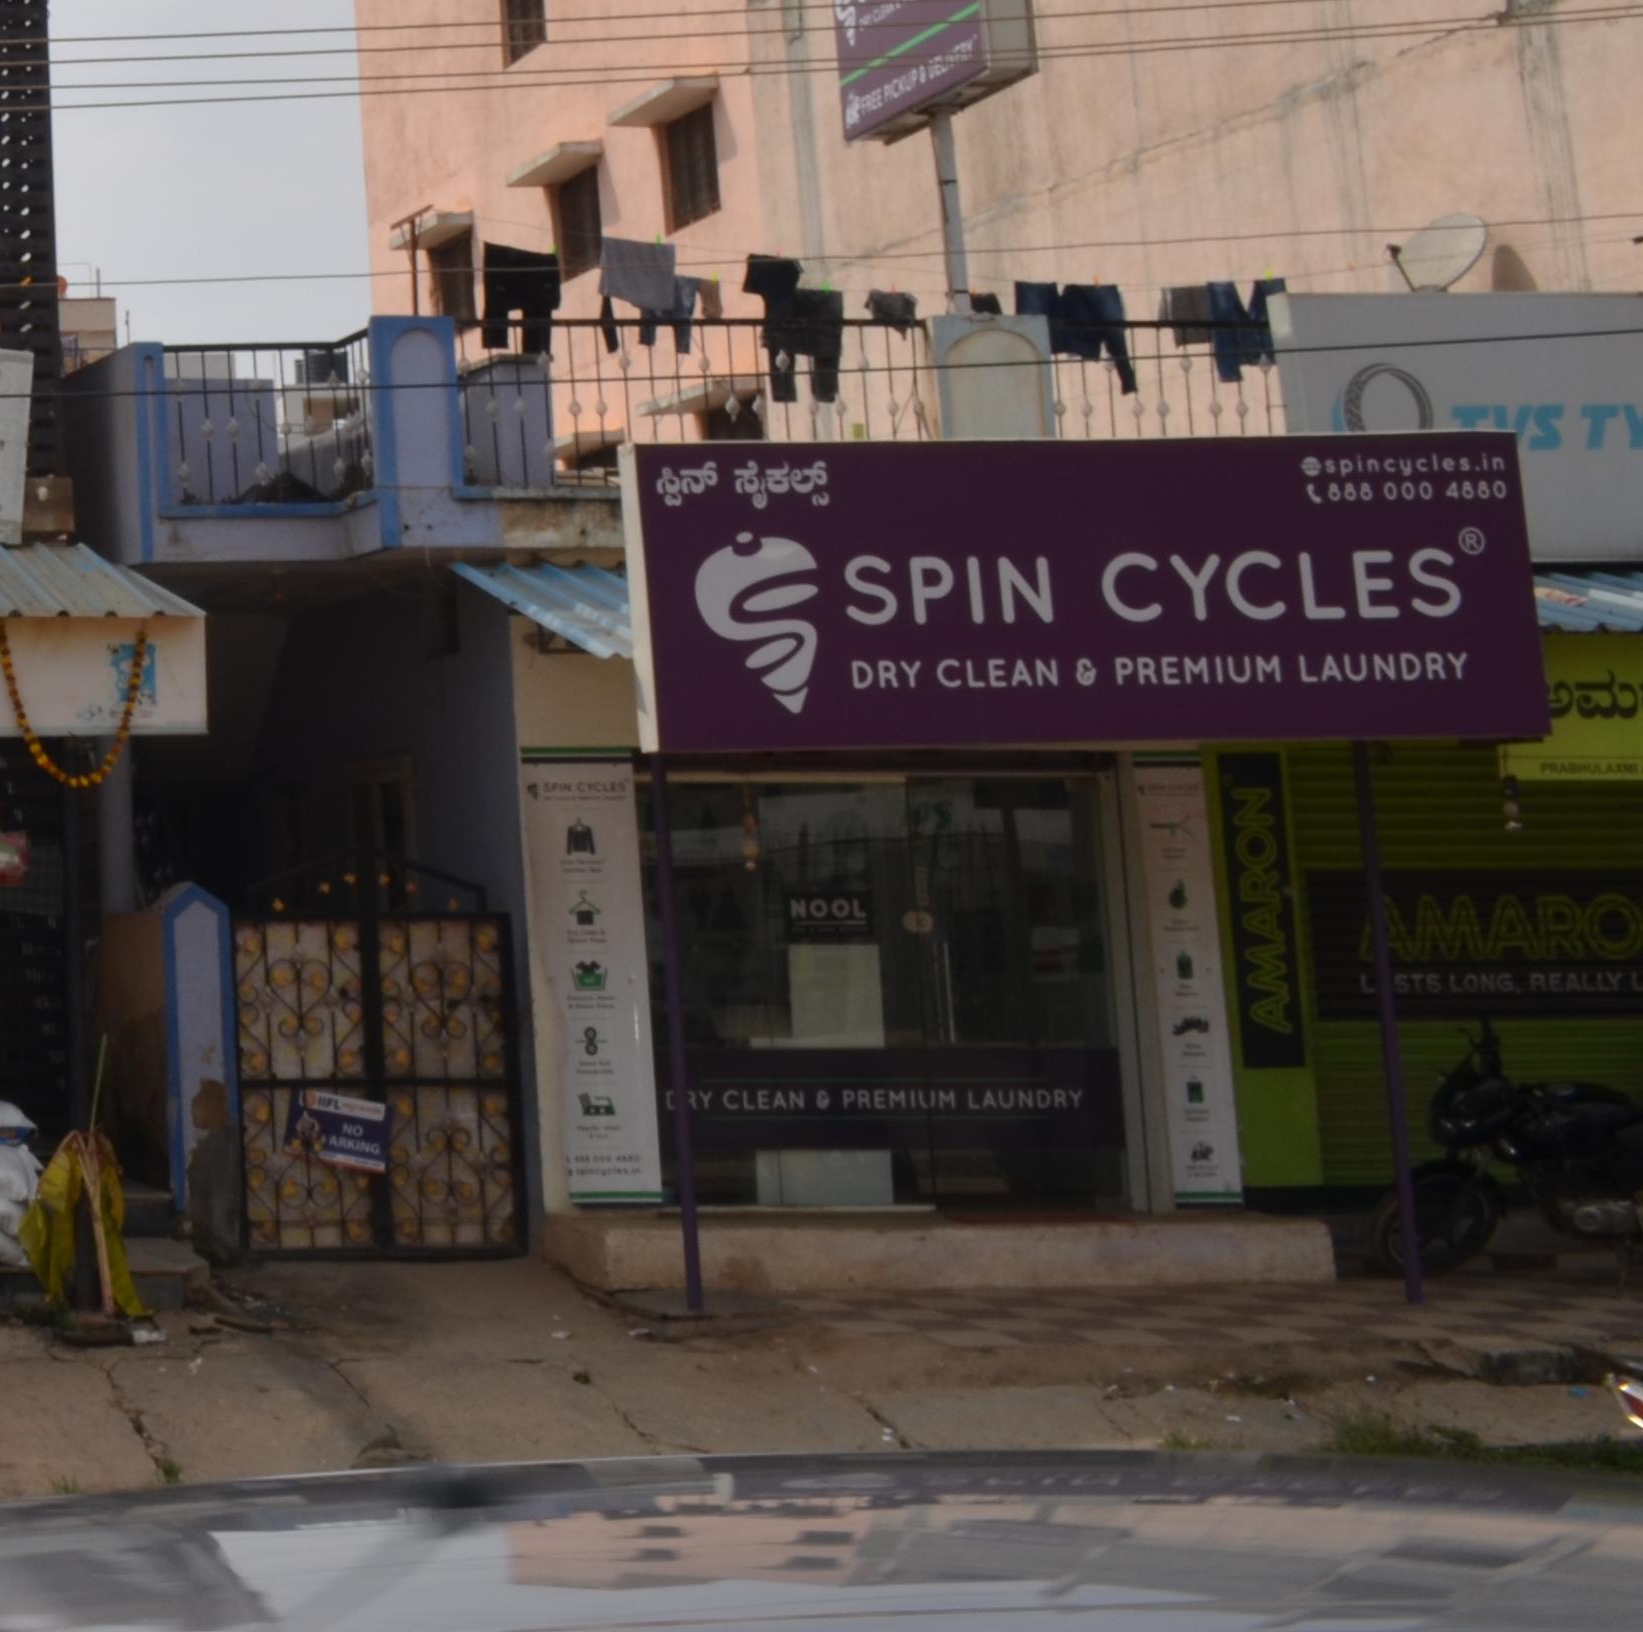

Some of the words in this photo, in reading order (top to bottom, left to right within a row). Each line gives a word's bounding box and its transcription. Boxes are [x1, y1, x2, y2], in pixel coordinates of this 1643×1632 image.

[860, 86, 883, 114] FREE
[883, 67, 919, 102] PICKUP
[1325, 453, 1506, 476] spincycles.in
[734, 460, 830, 508] ಸೈಕಲ್ಸ್
[1328, 481, 1373, 501] 888
[1384, 481, 1433, 500] 000
[1446, 480, 1507, 499] 4880
[845, 554, 1054, 627] SPIN
[851, 661, 922, 689] DRY
[936, 659, 1060, 688] CLEAN
[1076, 659, 1097, 686] &
[1115, 656, 1282, 686] PREMIUM
[1298, 653, 1469, 684] LAUNDRY
[544, 782, 572, 793] SPIN
[577, 781, 625, 793] CYCLES
[790, 898, 867, 919] NOOL
[1231, 787, 1292, 1034] AMARON
[1359, 892, 1643, 961] AMARO
[1360, 973, 1442, 993] LSTS
[1530, 972, 1623, 992] REALLY
[722, 1089, 806, 1111] CLEAN
[816, 1089, 830, 1109] &
[842, 1089, 956, 1110] PREMIUM
[968, 1088, 1084, 1109] LAUNDRY
[342, 1122, 364, 1137] NO
